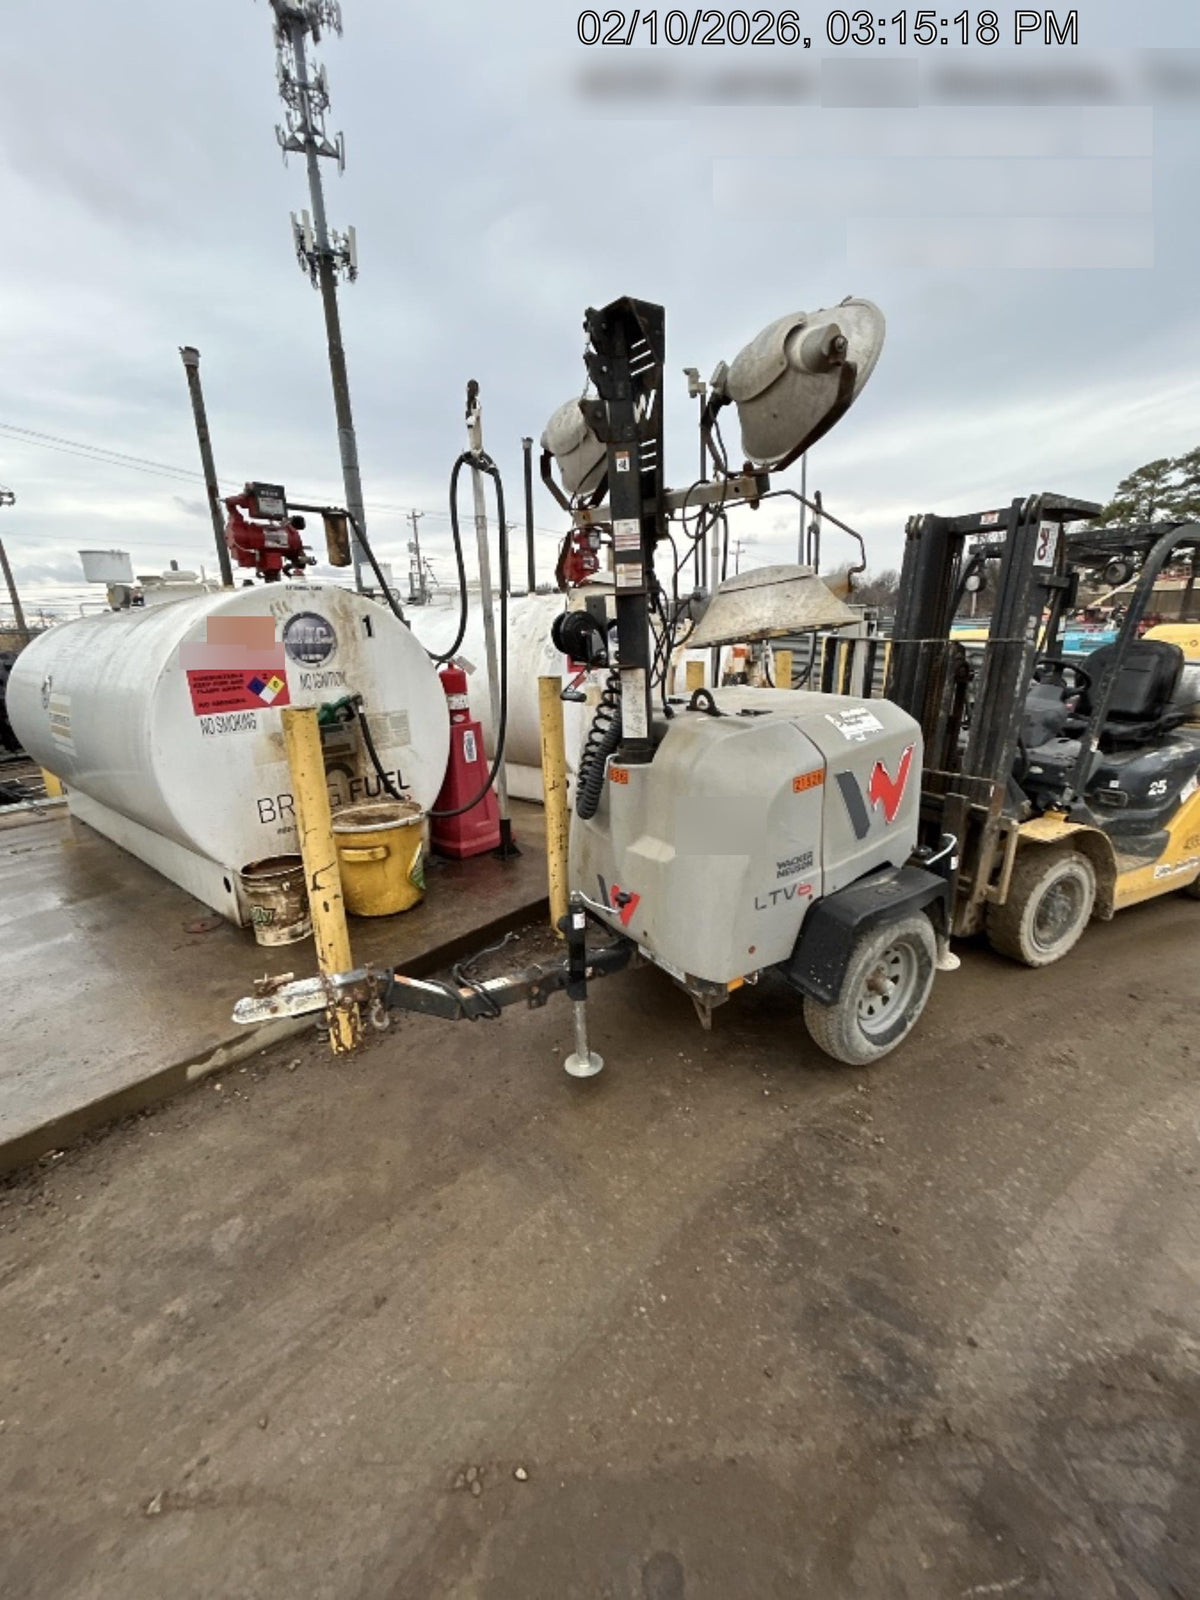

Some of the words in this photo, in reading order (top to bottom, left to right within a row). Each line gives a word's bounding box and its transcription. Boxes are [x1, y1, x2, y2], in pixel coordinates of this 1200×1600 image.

[362, 615, 373, 637] 1
[200, 717, 215, 736] NO
[215, 712, 257, 733] SMOKING
[351, 769, 410, 802] FUEL
[1148, 780, 1167, 796] 25
[776, 851, 813, 870] WACKER
[776, 860, 813, 879] NEUSON
